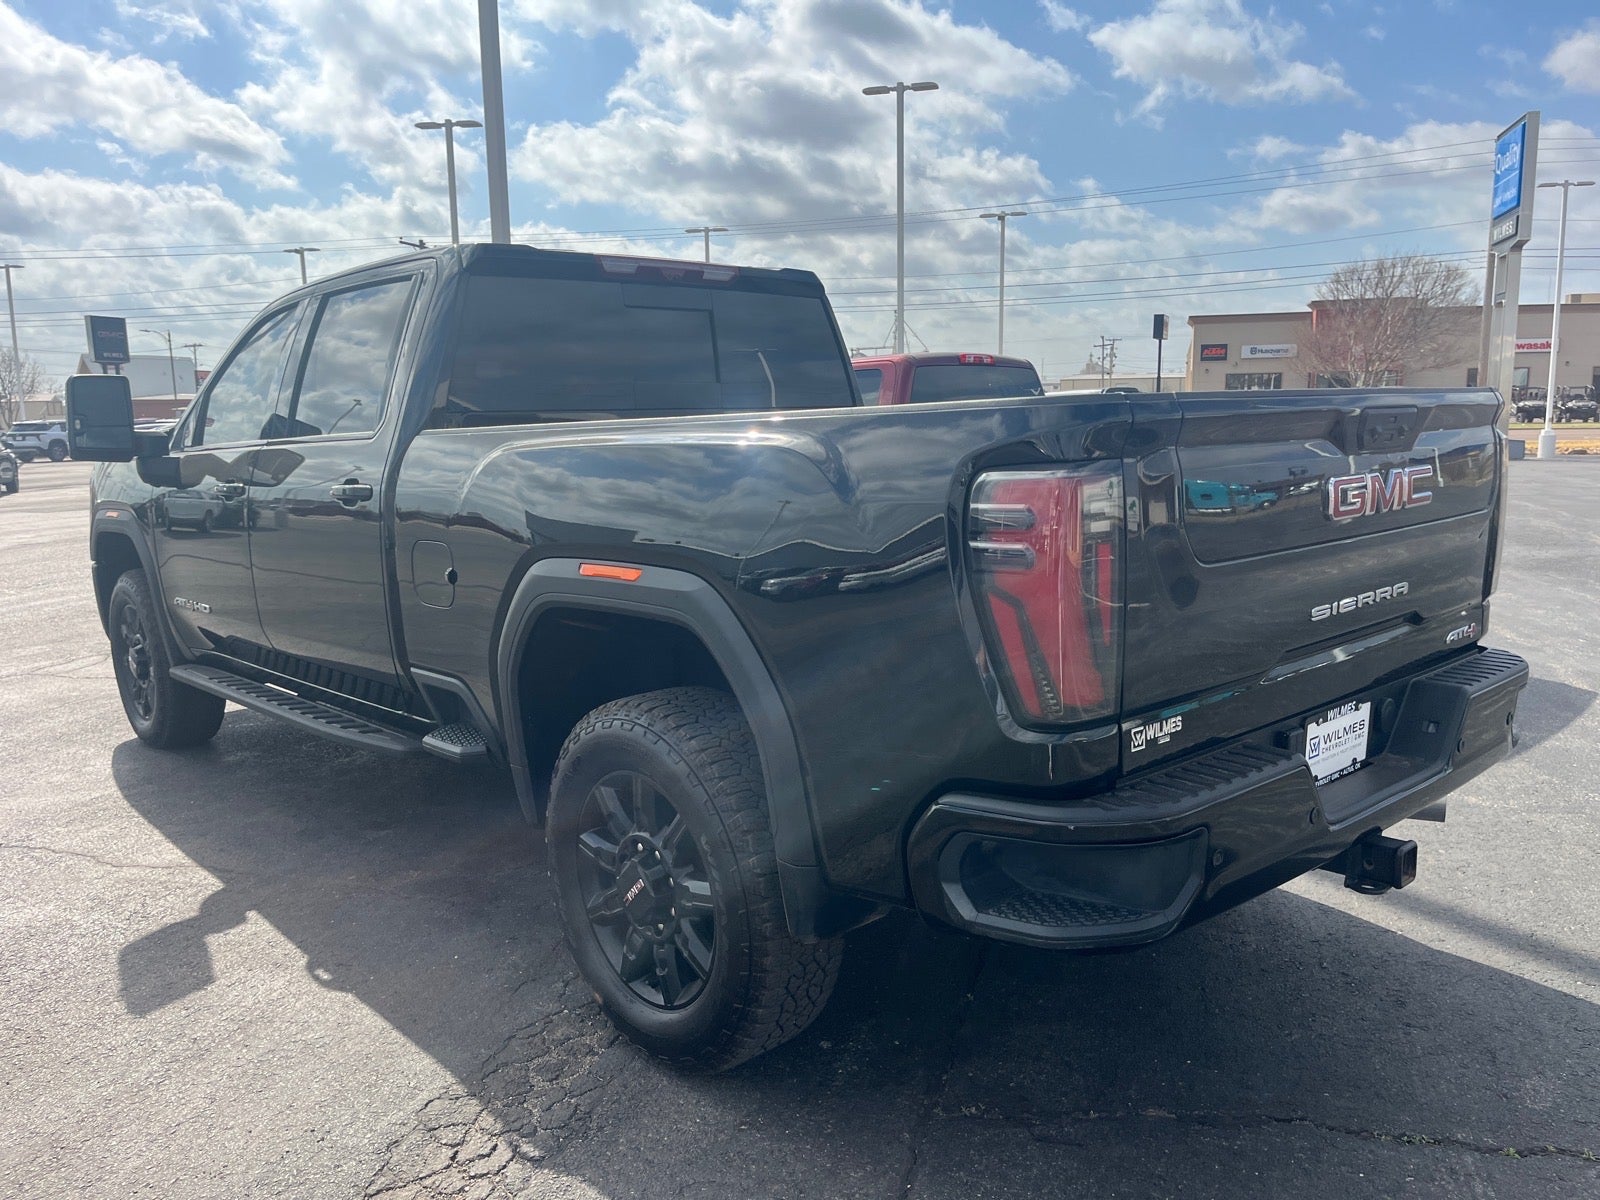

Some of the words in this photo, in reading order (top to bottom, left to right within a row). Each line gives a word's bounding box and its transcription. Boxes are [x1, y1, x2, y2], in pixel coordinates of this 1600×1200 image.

[1495, 143, 1520, 174] Quality
[1515, 341, 1552, 351] wasak
[1328, 464, 1433, 520] GMC
[1311, 581, 1409, 622] SIERRA
[1445, 622, 1477, 645] AT4
[1327, 701, 1357, 722] WILMES
[1145, 715, 1182, 741] WILMES
[1322, 719, 1366, 745] WILMES
[1321, 737, 1351, 754] CHEVROLET
